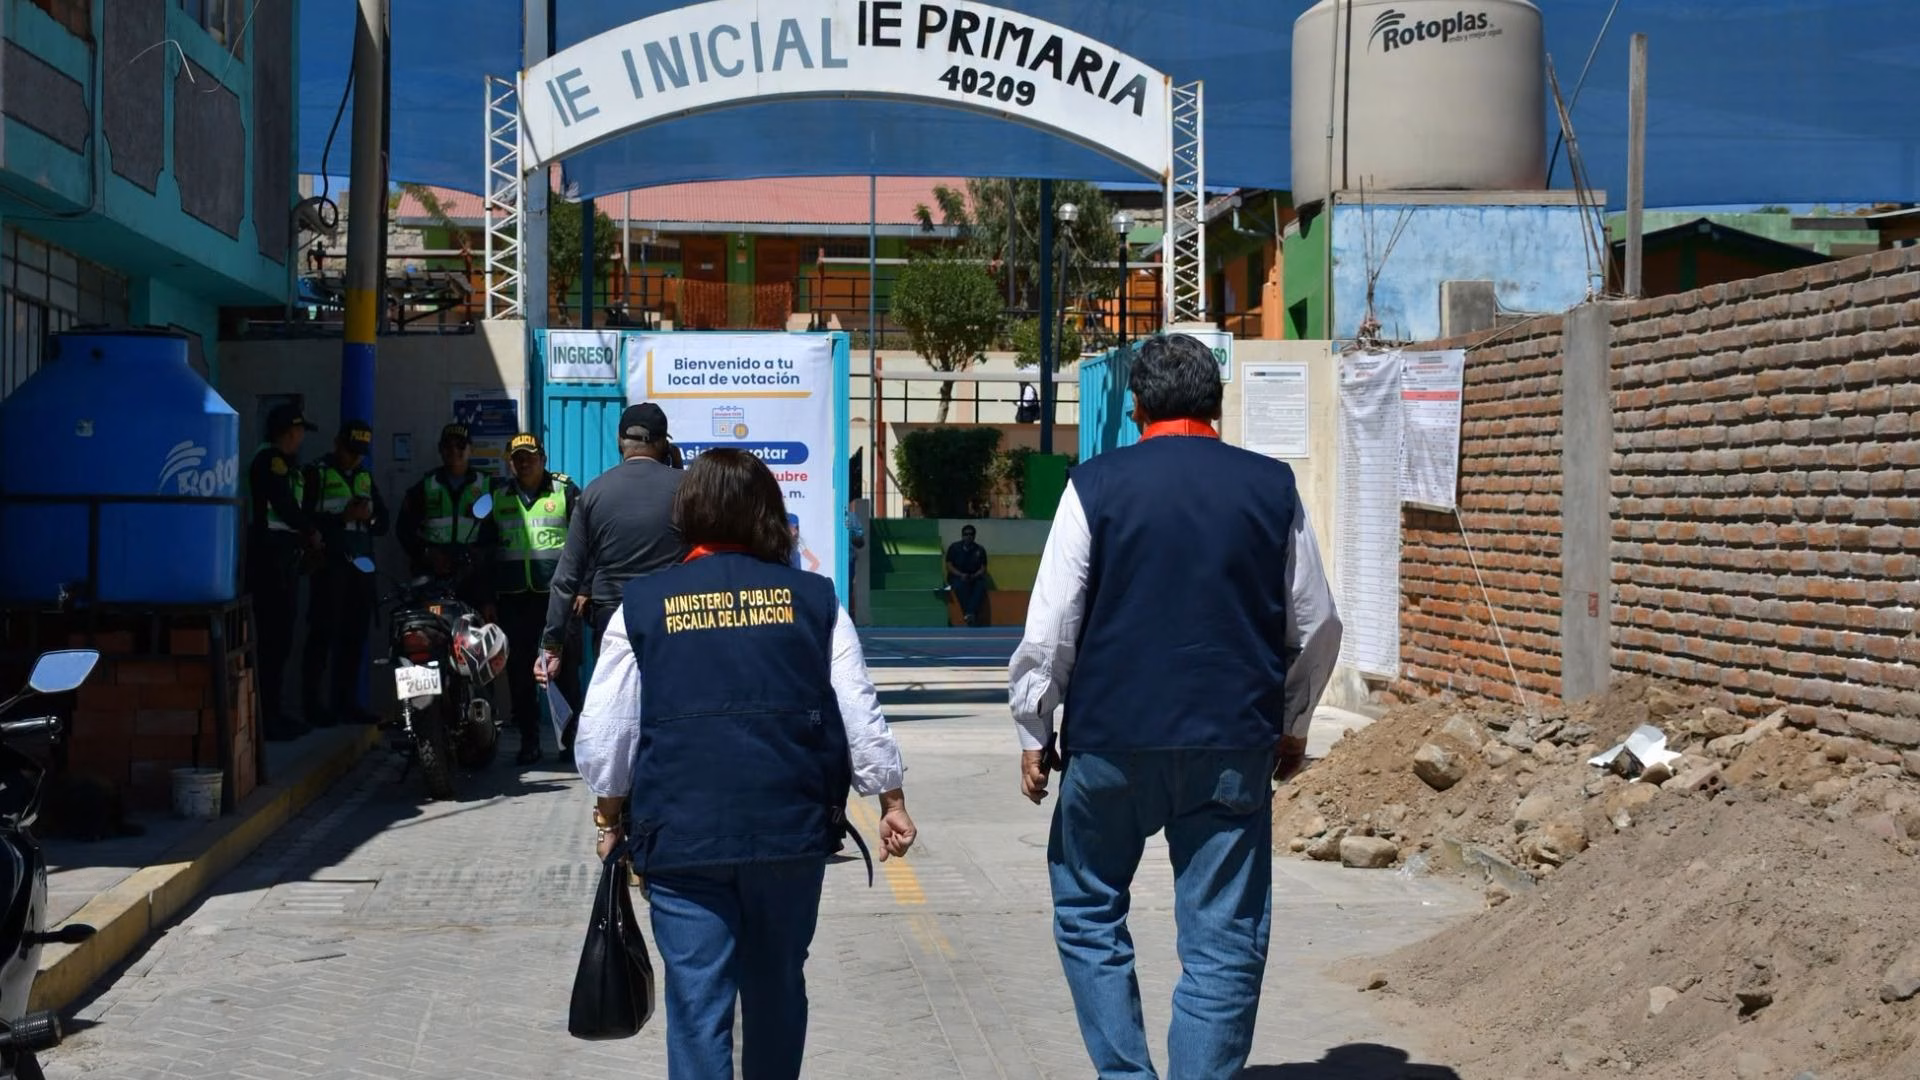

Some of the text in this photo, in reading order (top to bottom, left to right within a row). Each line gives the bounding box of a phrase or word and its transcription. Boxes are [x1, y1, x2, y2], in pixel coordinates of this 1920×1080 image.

[1383, 11, 1488, 52] Rotoplas
[545, 17, 849, 128] IE INICIAL
[858, 1, 1148, 117] IE PRIMARIA
[939, 65, 1036, 107] 40209
[553, 346, 614, 365] INGRESO
[674, 357, 794, 370] Bienvenido a tu
[668, 372, 800, 385] local de votación
[750, 447, 788, 460] otar
[776, 471, 808, 482] ubre
[664, 588, 791, 615] MINISTERIO PUBLICO
[666, 606, 794, 634] FISCALIA DE LA NACION
